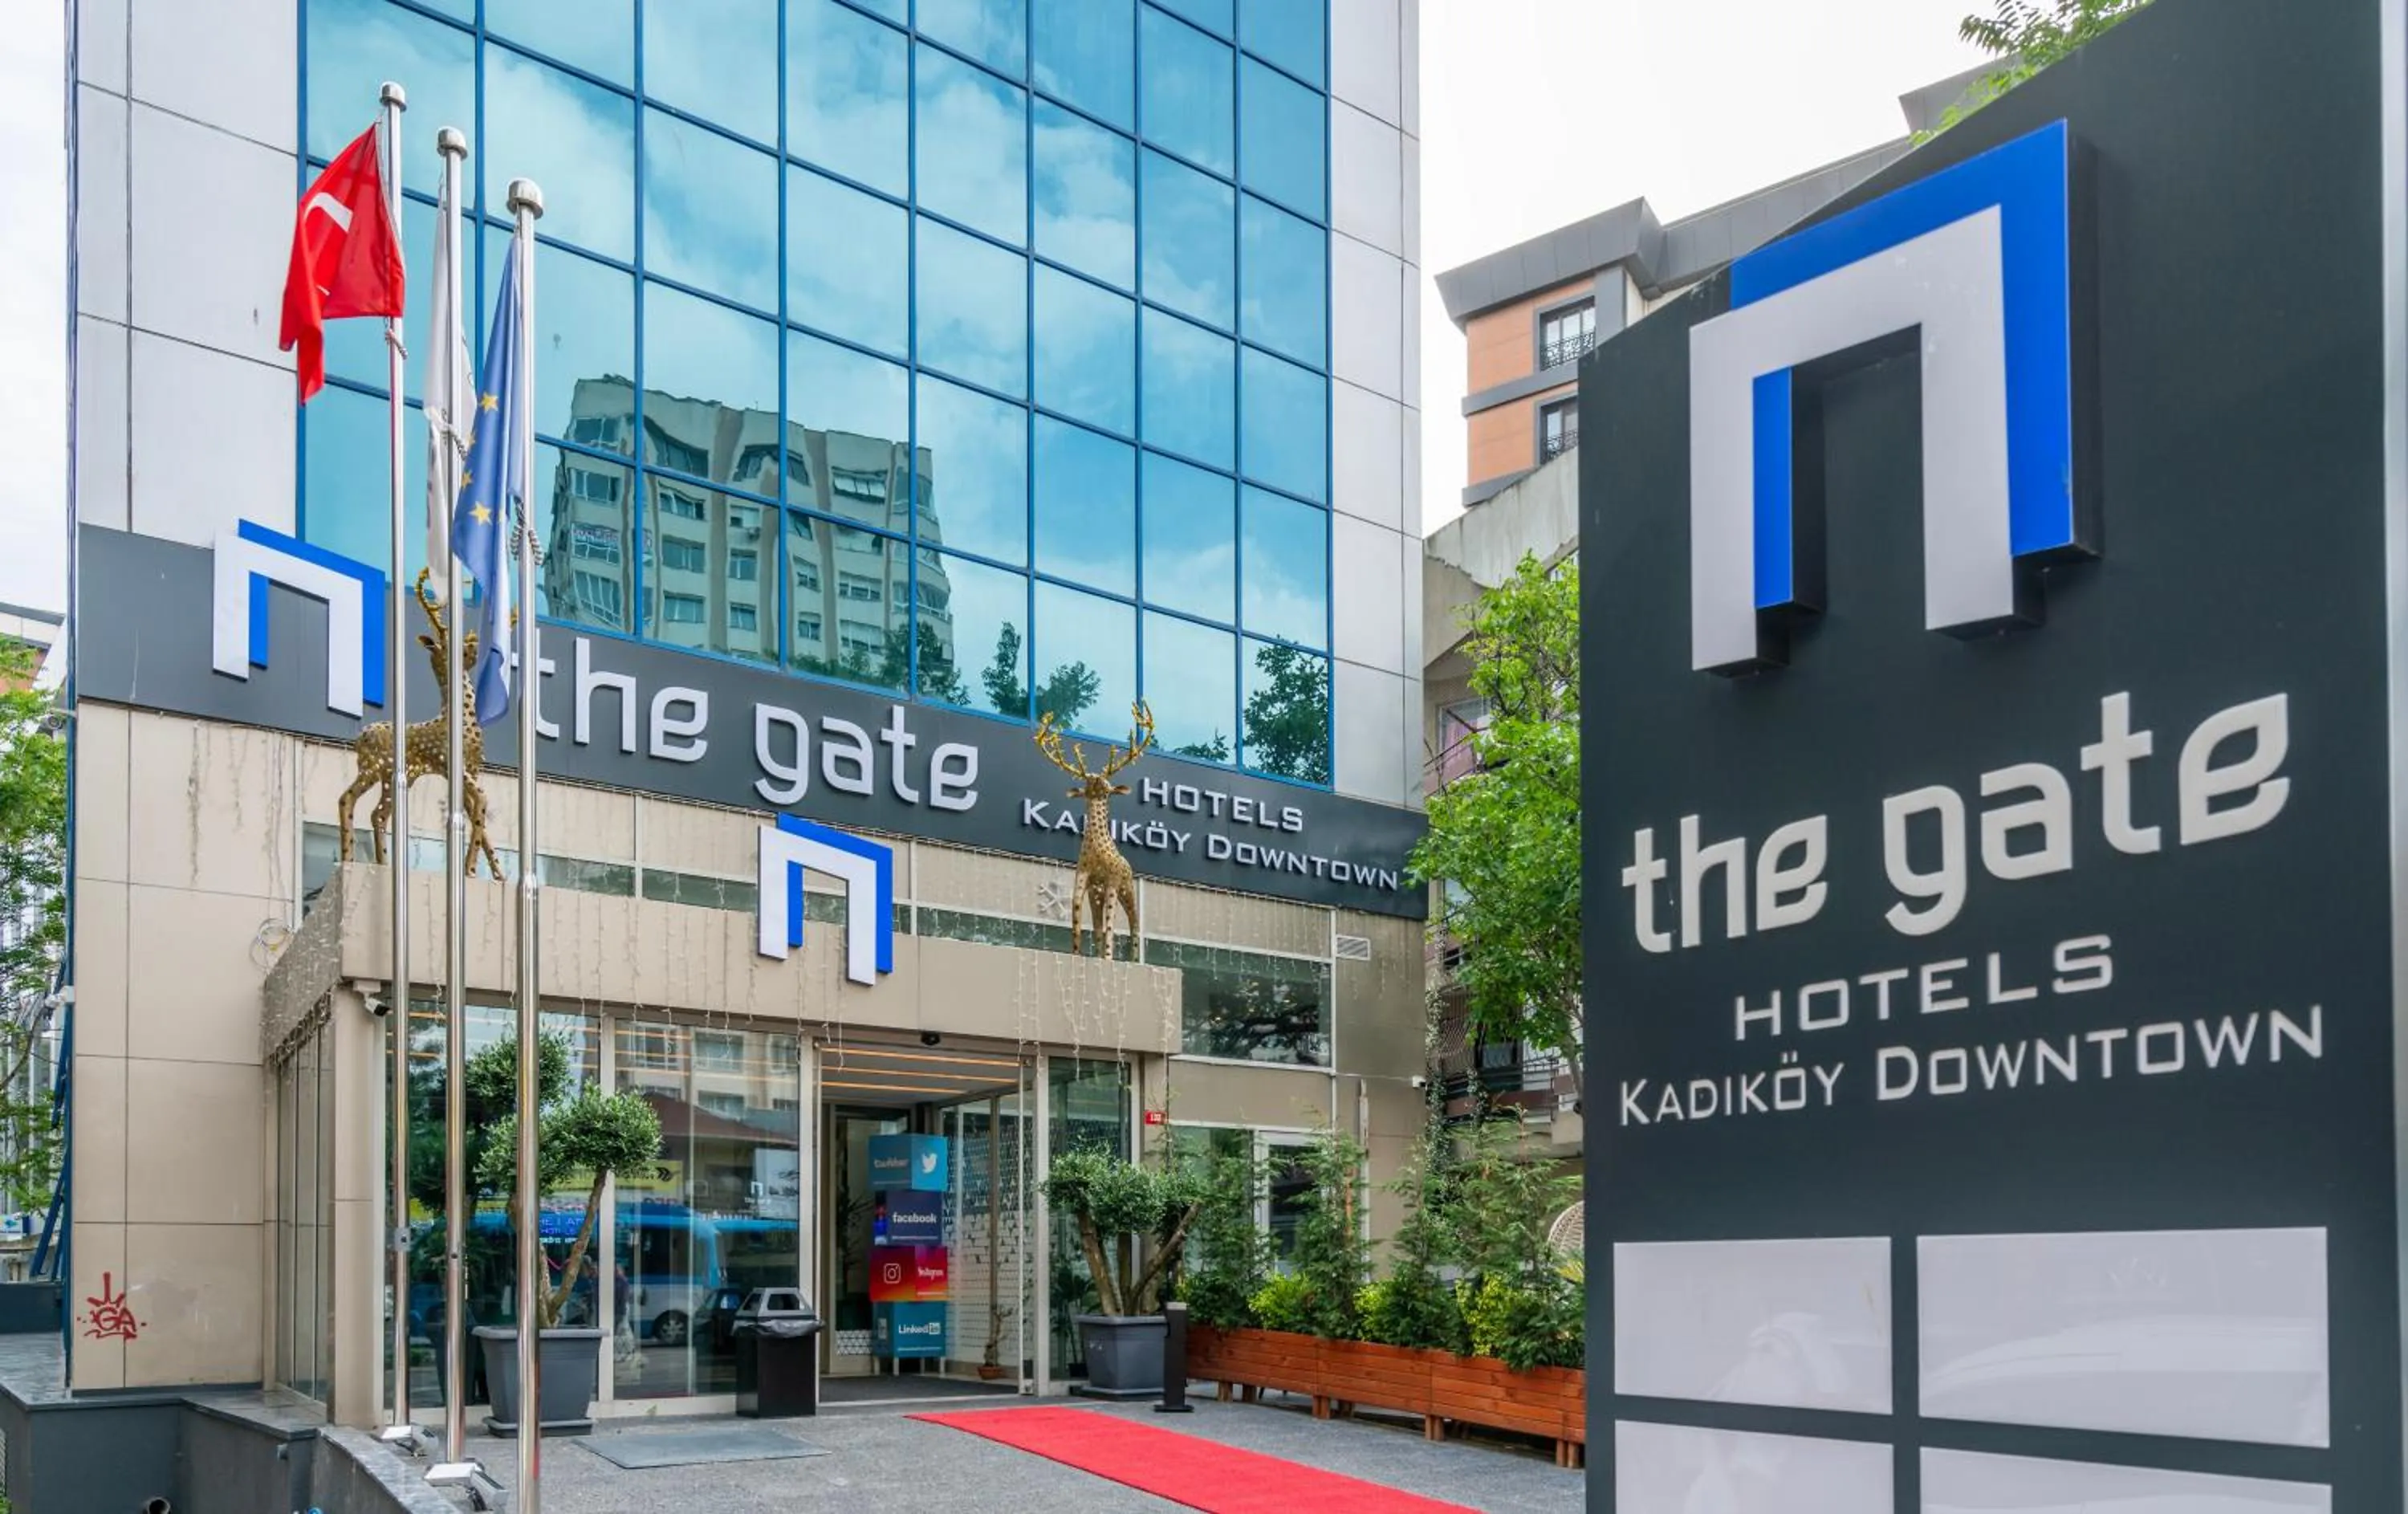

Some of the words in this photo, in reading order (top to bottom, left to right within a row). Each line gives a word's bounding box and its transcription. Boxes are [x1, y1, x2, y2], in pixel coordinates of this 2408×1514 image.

[511, 627, 709, 762] the
[755, 702, 979, 811] gate
[1023, 796, 1193, 853] KAIKÖY
[1207, 832, 1399, 892] DOWNTOWN
[1142, 775, 1304, 832] HOTELS
[1621, 813, 1828, 953] the
[1881, 690, 2292, 937] gate
[1735, 934, 2113, 1041] HOTELS
[1621, 1052, 1845, 1127] KADIKÖY
[1877, 1004, 2323, 1101] DOWNTOWN
[892, 1211, 938, 1225] facebook
